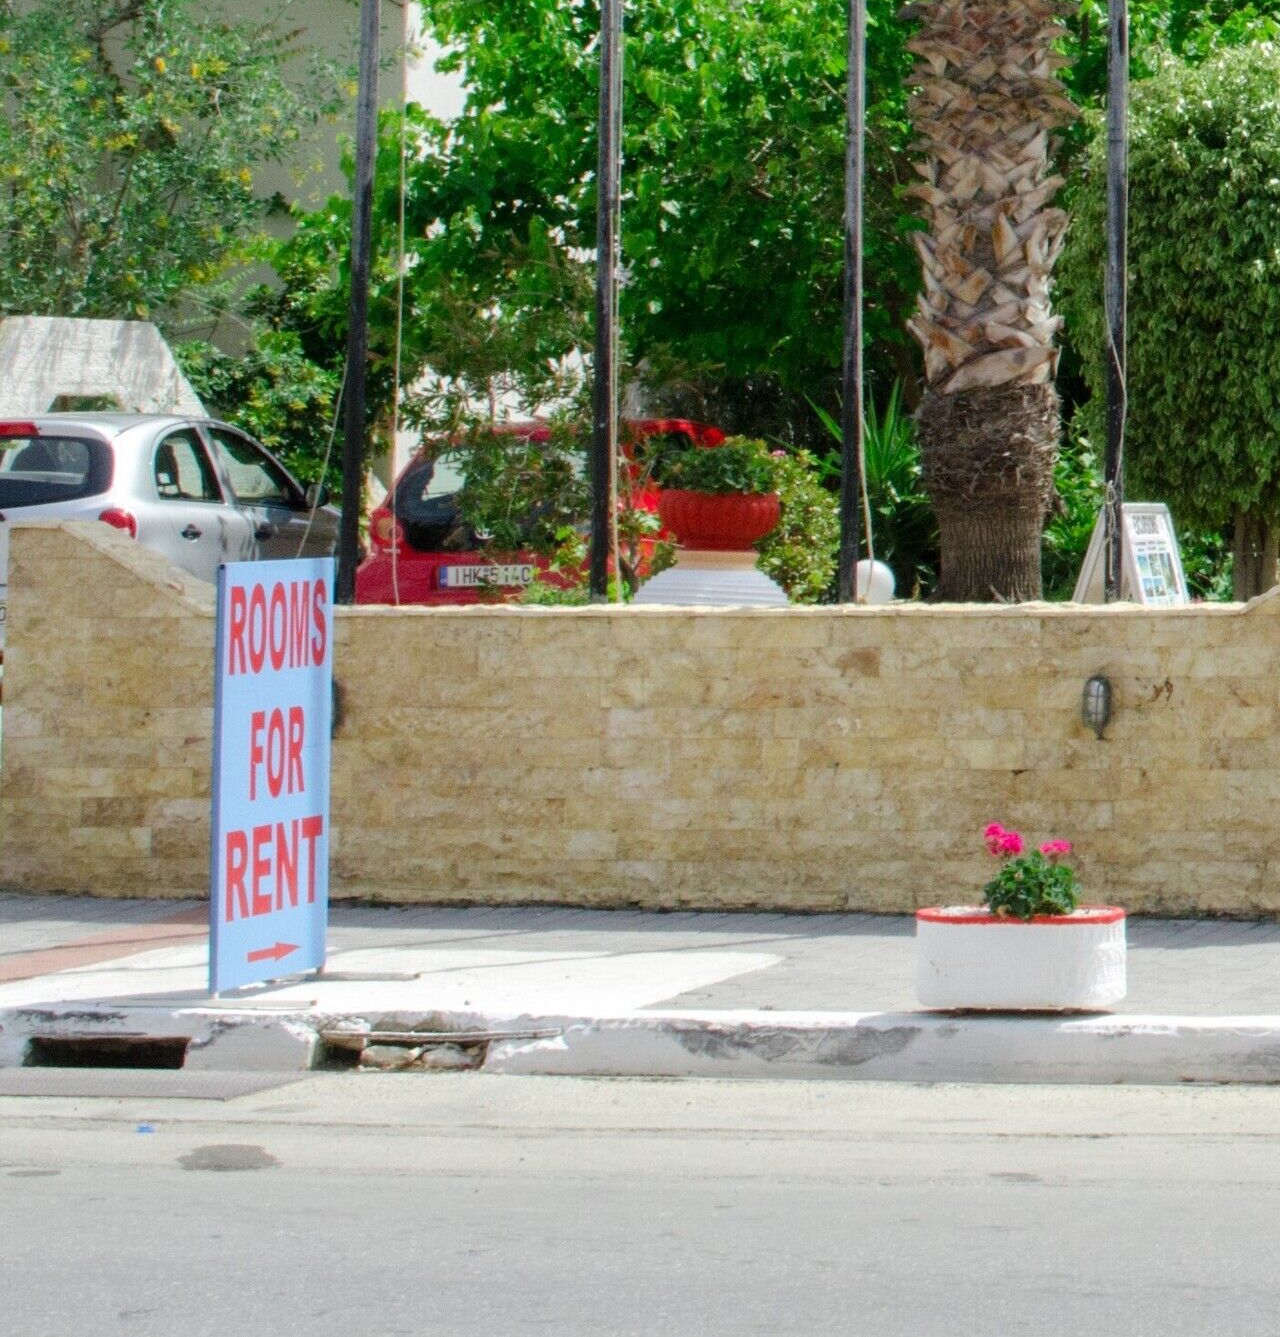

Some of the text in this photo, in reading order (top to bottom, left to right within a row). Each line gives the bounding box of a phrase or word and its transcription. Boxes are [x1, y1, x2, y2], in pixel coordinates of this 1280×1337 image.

[229, 578, 327, 676] ROOMS
[249, 706, 306, 801] FOR
[225, 815, 324, 922] RENT
